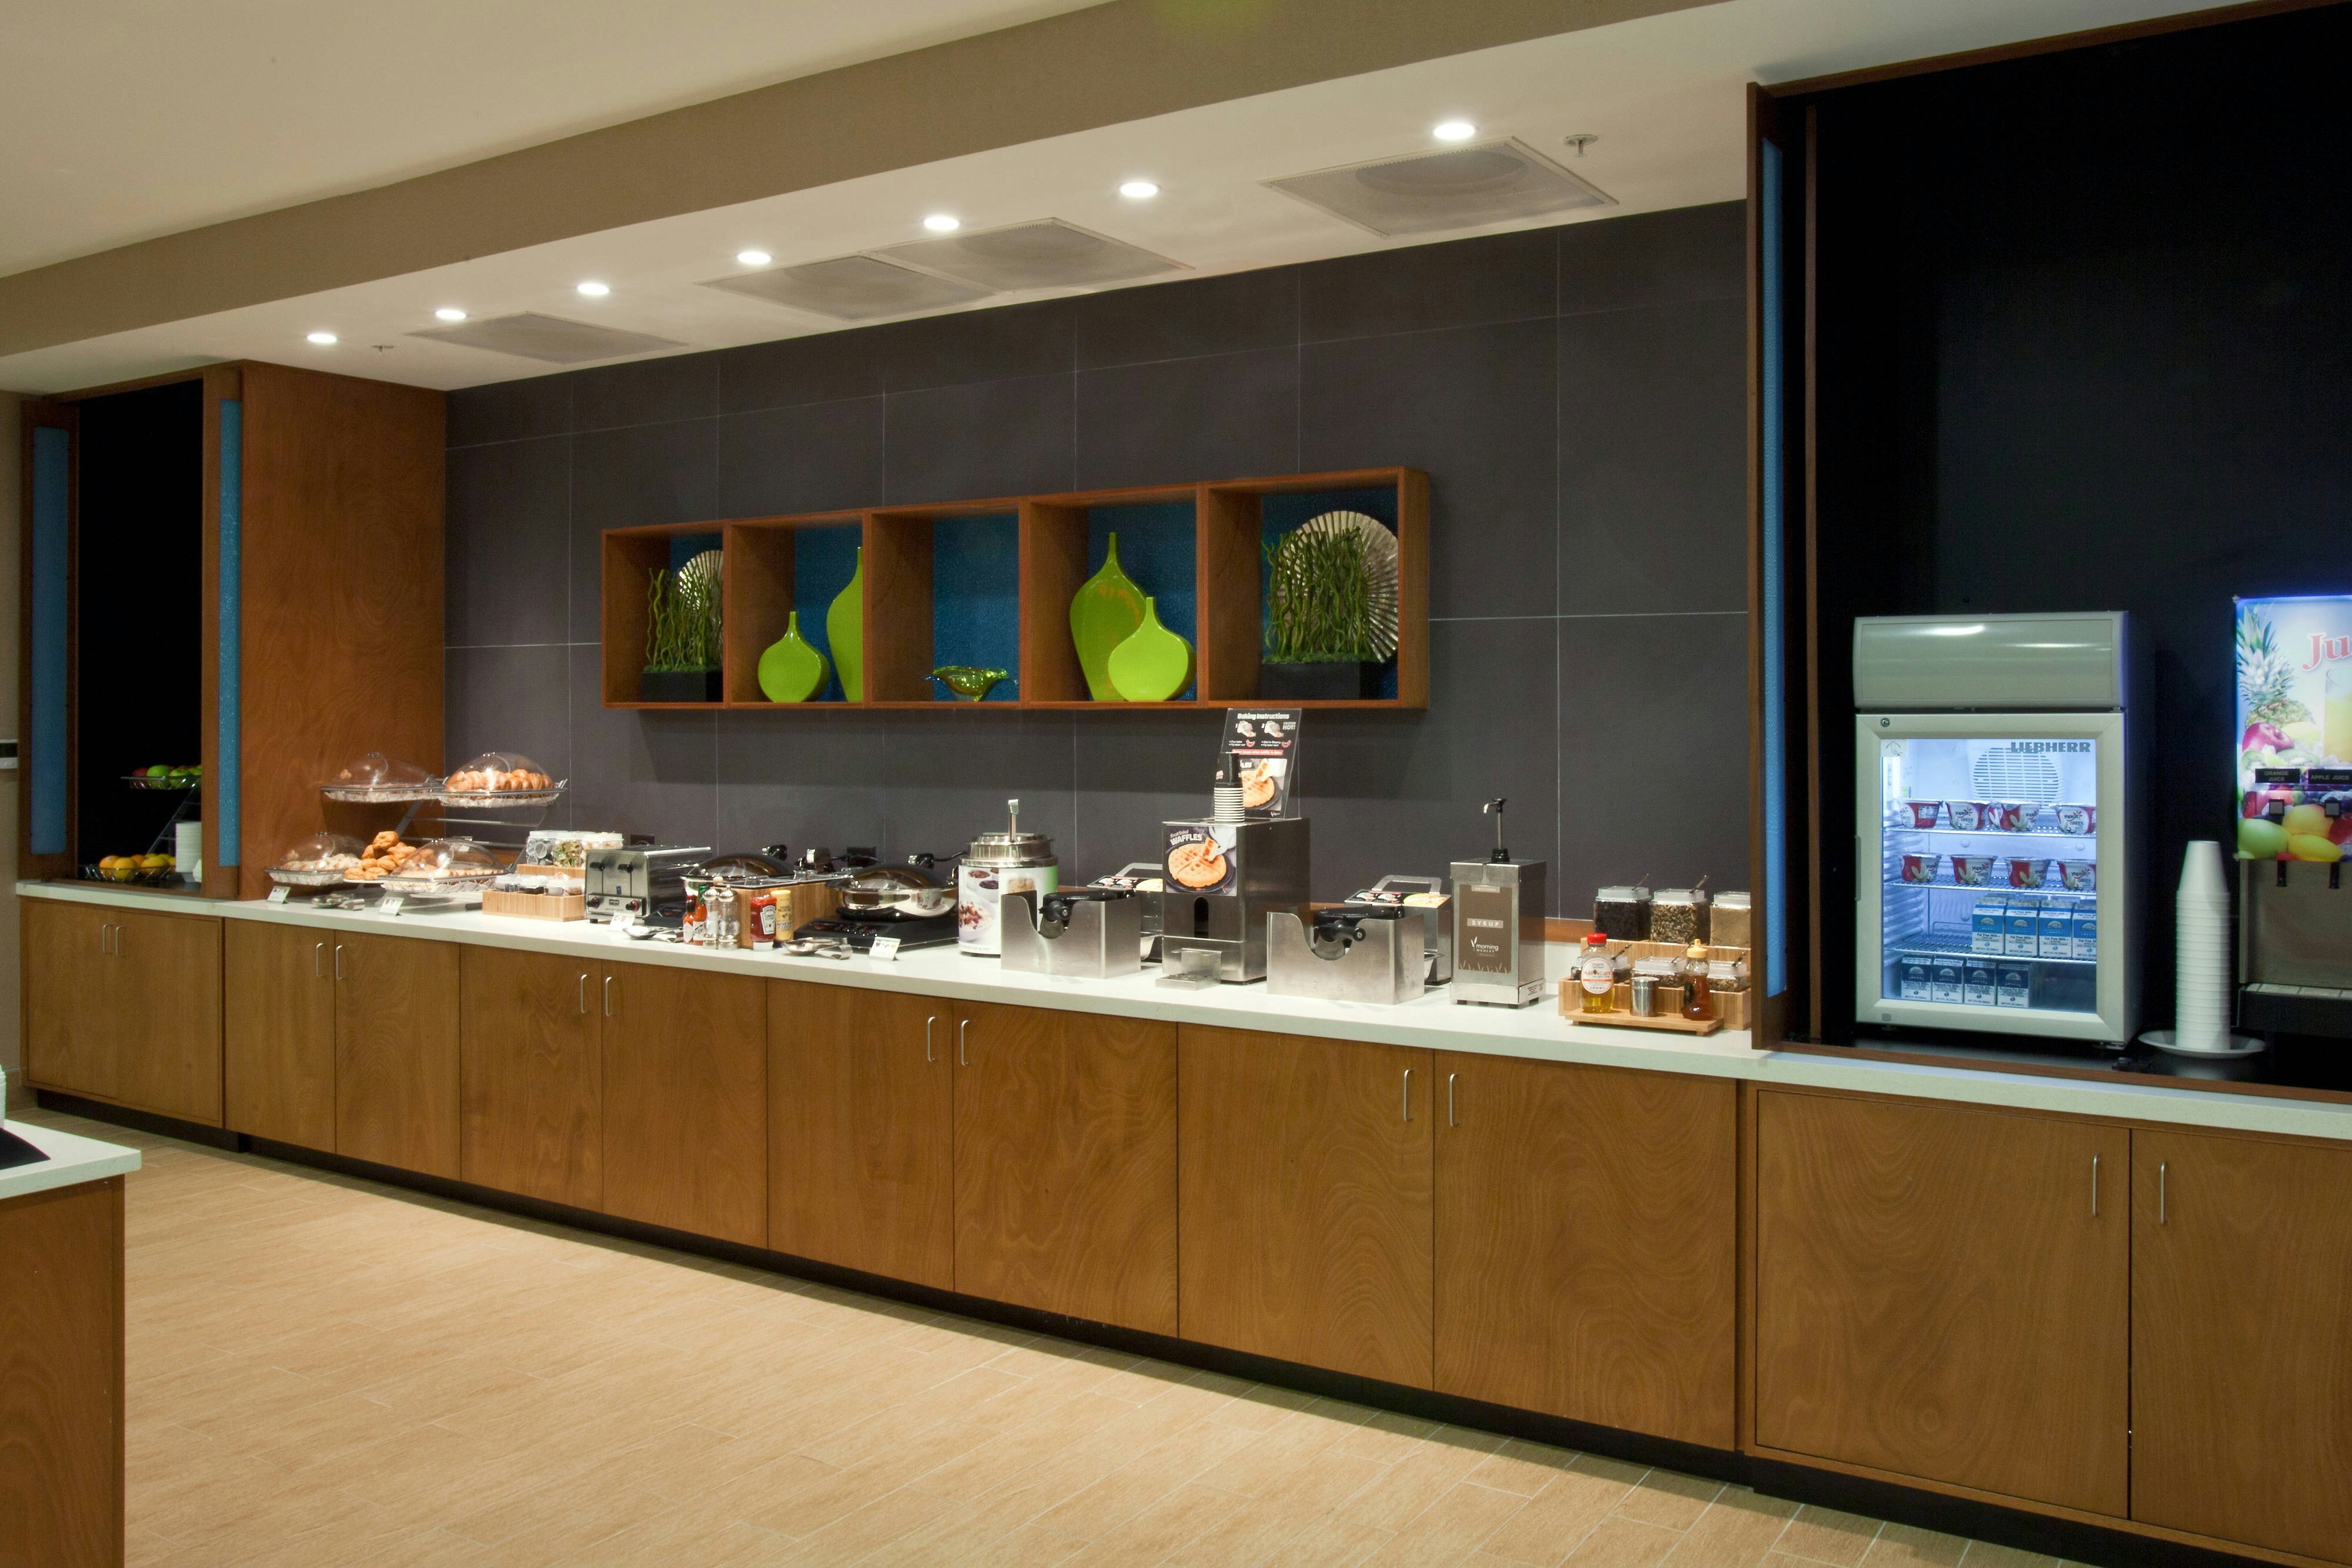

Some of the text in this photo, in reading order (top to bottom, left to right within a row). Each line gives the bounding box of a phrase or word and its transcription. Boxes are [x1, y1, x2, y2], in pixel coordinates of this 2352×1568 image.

[2010, 741, 2092, 753] LIEBHERR
[1170, 833, 1202, 846] WAFFLES
[1476, 943, 1499, 952] morning
